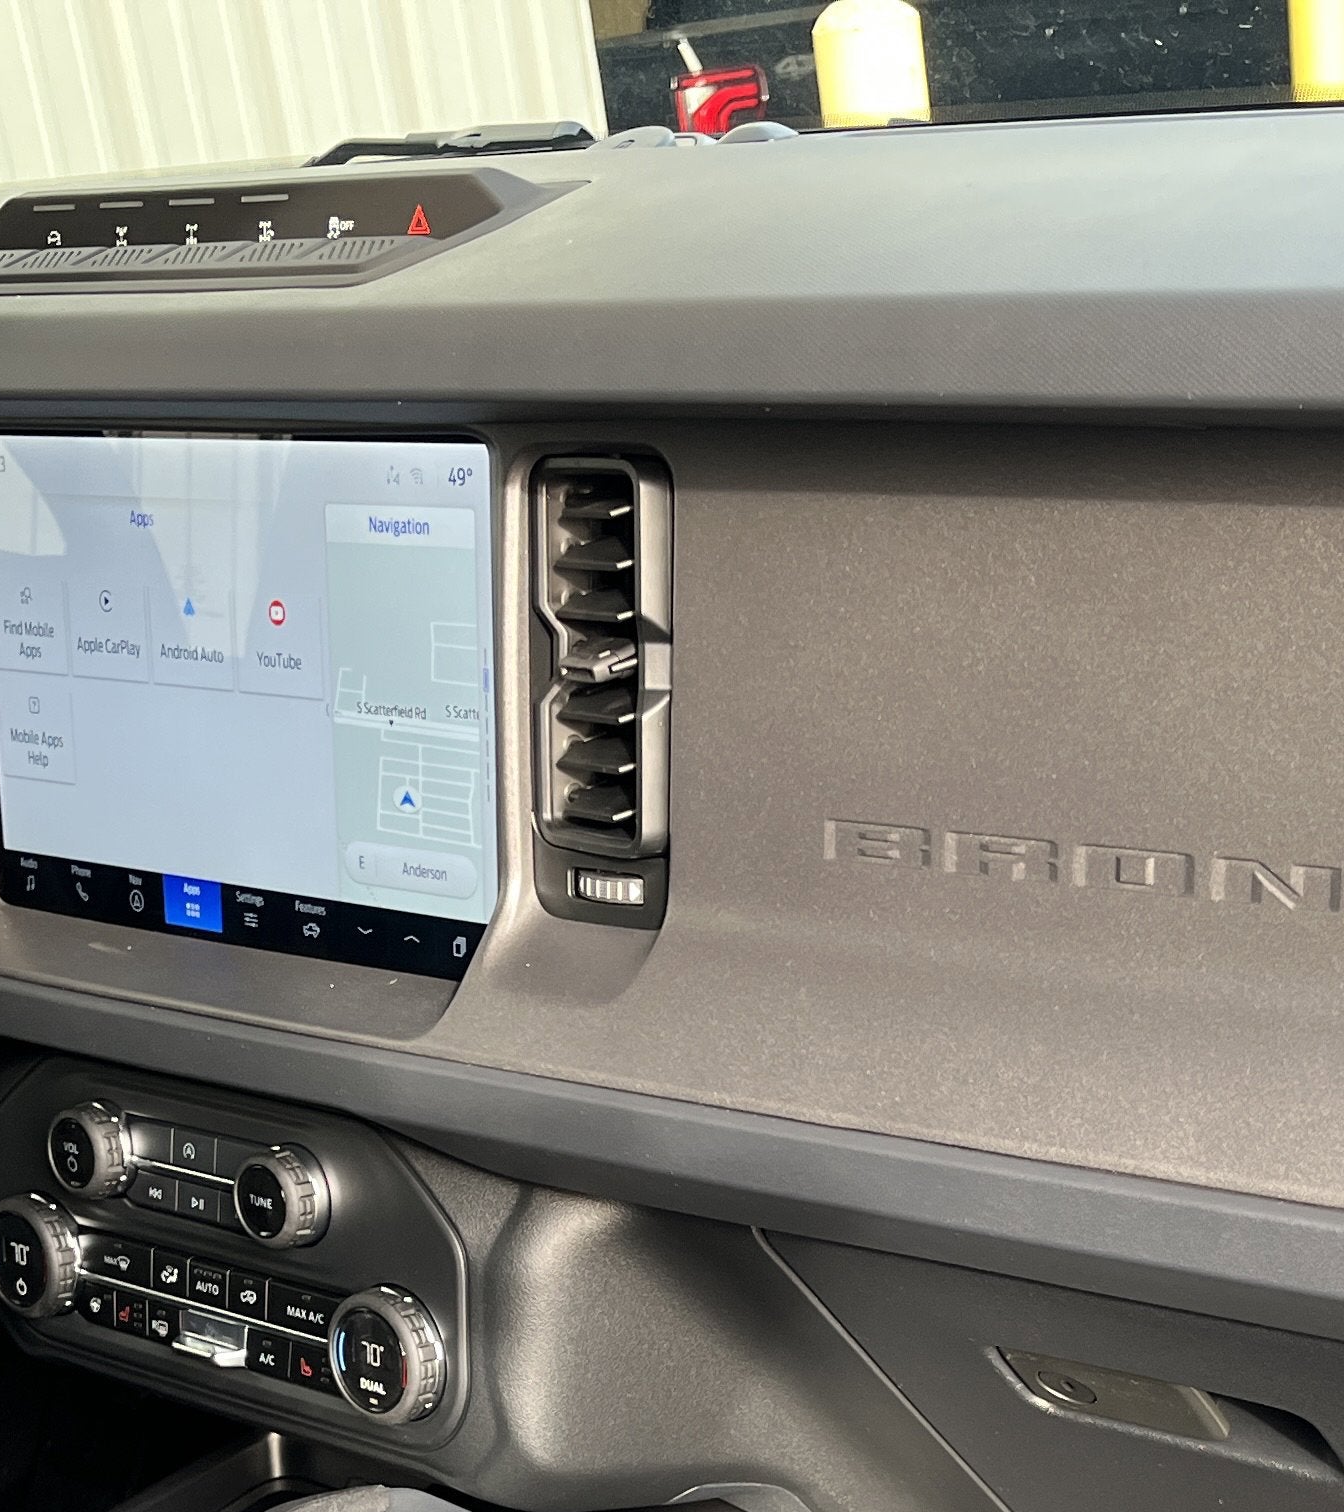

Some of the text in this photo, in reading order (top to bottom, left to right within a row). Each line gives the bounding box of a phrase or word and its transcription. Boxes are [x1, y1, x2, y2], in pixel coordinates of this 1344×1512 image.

[340, 220, 355, 231] OFF
[129, 510, 154, 528] Apps
[368, 516, 430, 537] Navigation
[3, 620, 55, 639] Find Mobile
[19, 643, 42, 660] Apps
[77, 637, 141, 659] Apple CarPlay
[160, 644, 224, 664] Android Auto
[256, 652, 302, 670] YouTube
[356, 701, 427, 720] S Scatterfield Rd
[445, 705, 452, 718] S
[10, 728, 64, 750] Mobile Apps
[27, 751, 49, 768] Help
[359, 856, 366, 870] E
[402, 862, 448, 881] Anderson
[183, 883, 201, 896] Apps
[63, 1141, 80, 1155] VOL
[249, 1194, 273, 1210] TUNE
[196, 1280, 219, 1296] AUTO
[286, 1305, 325, 1325] MAX A/C
[259, 1353, 275, 1366] A/C
[359, 1377, 386, 1395] DUAL
